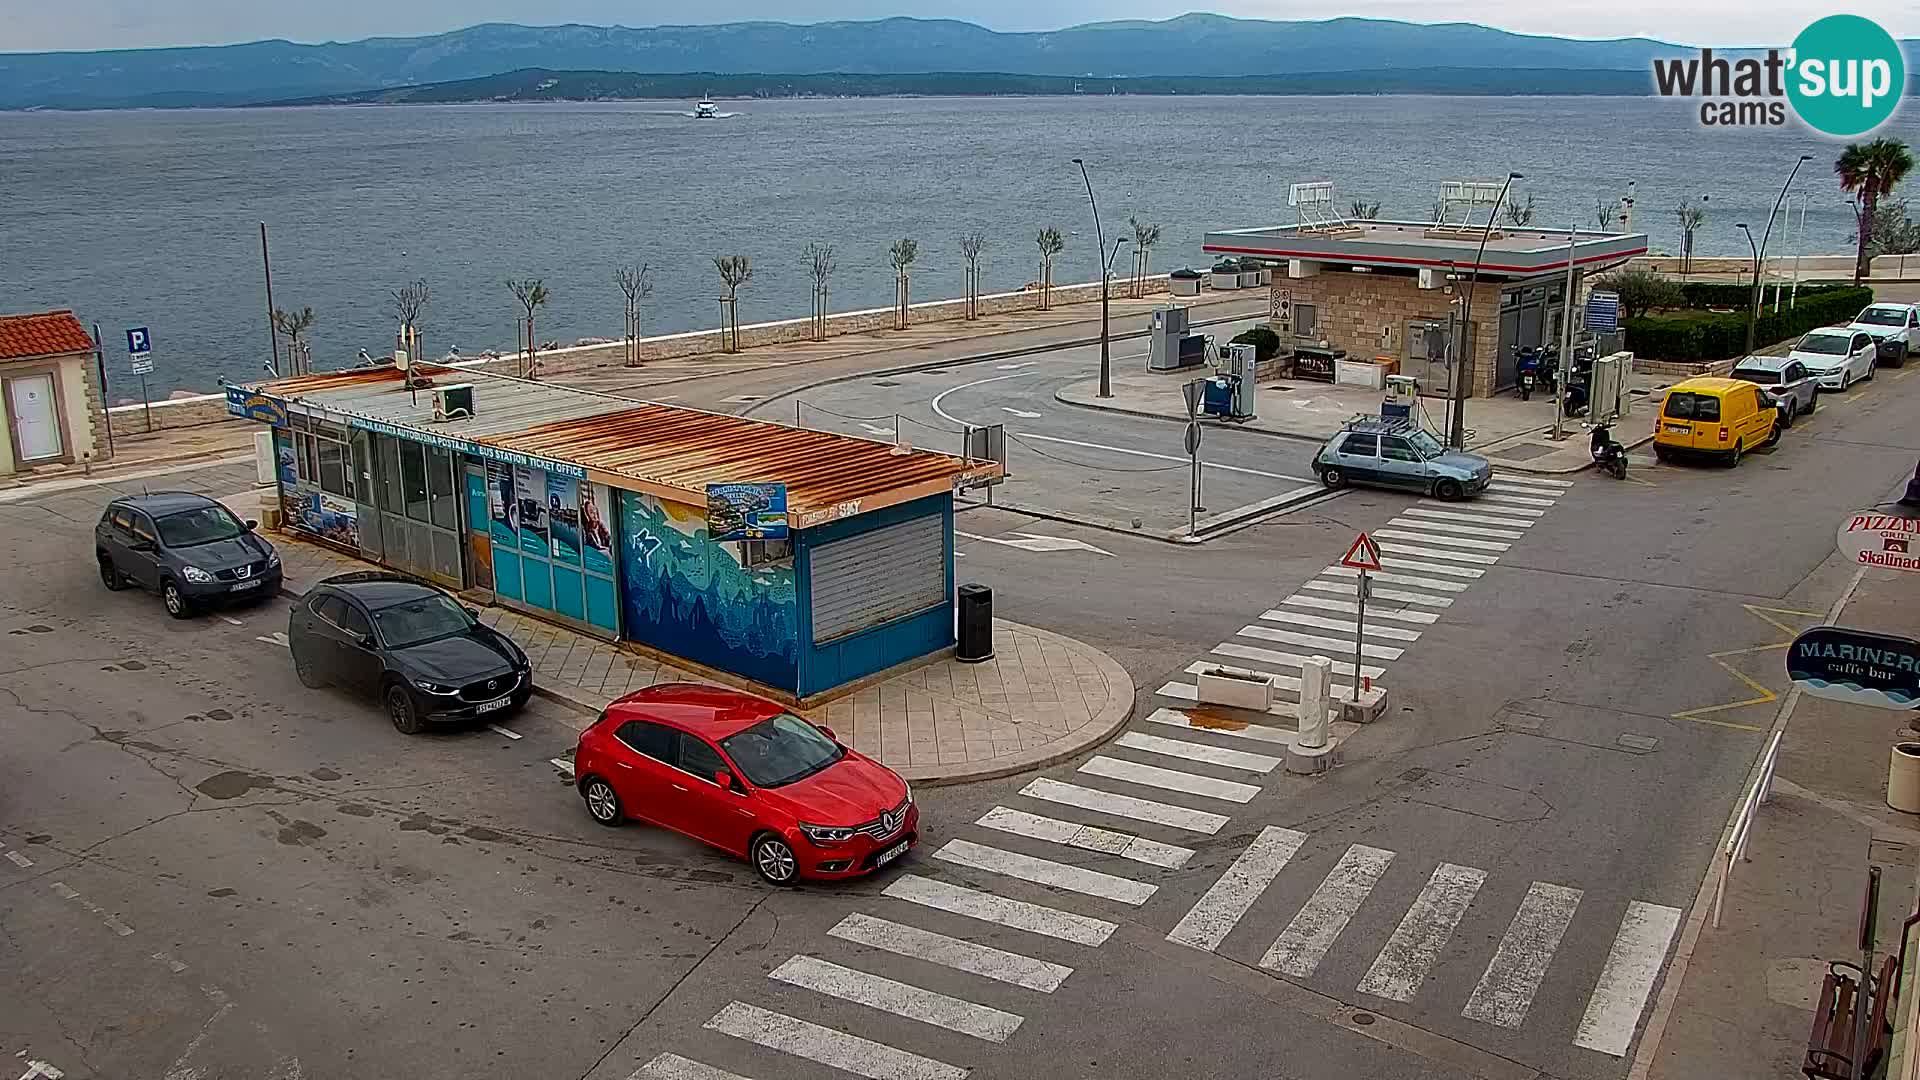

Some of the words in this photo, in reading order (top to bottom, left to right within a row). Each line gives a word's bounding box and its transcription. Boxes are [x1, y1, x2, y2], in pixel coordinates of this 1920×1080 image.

[131, 331, 145, 350] P
[397, 427, 437, 445] AUTOBUSNA
[437, 436, 469, 452] POSTAJA
[479, 446, 494, 459] BUS
[495, 450, 527, 465] STATION
[529, 457, 555, 471] TICKET
[556, 462, 583, 477] OFFICE
[1847, 515, 1920, 535] PIZZE
[1880, 530, 1915, 541] GRILL
[1827, 662, 1864, 676] caffe
[1868, 665, 1896, 680] bar
